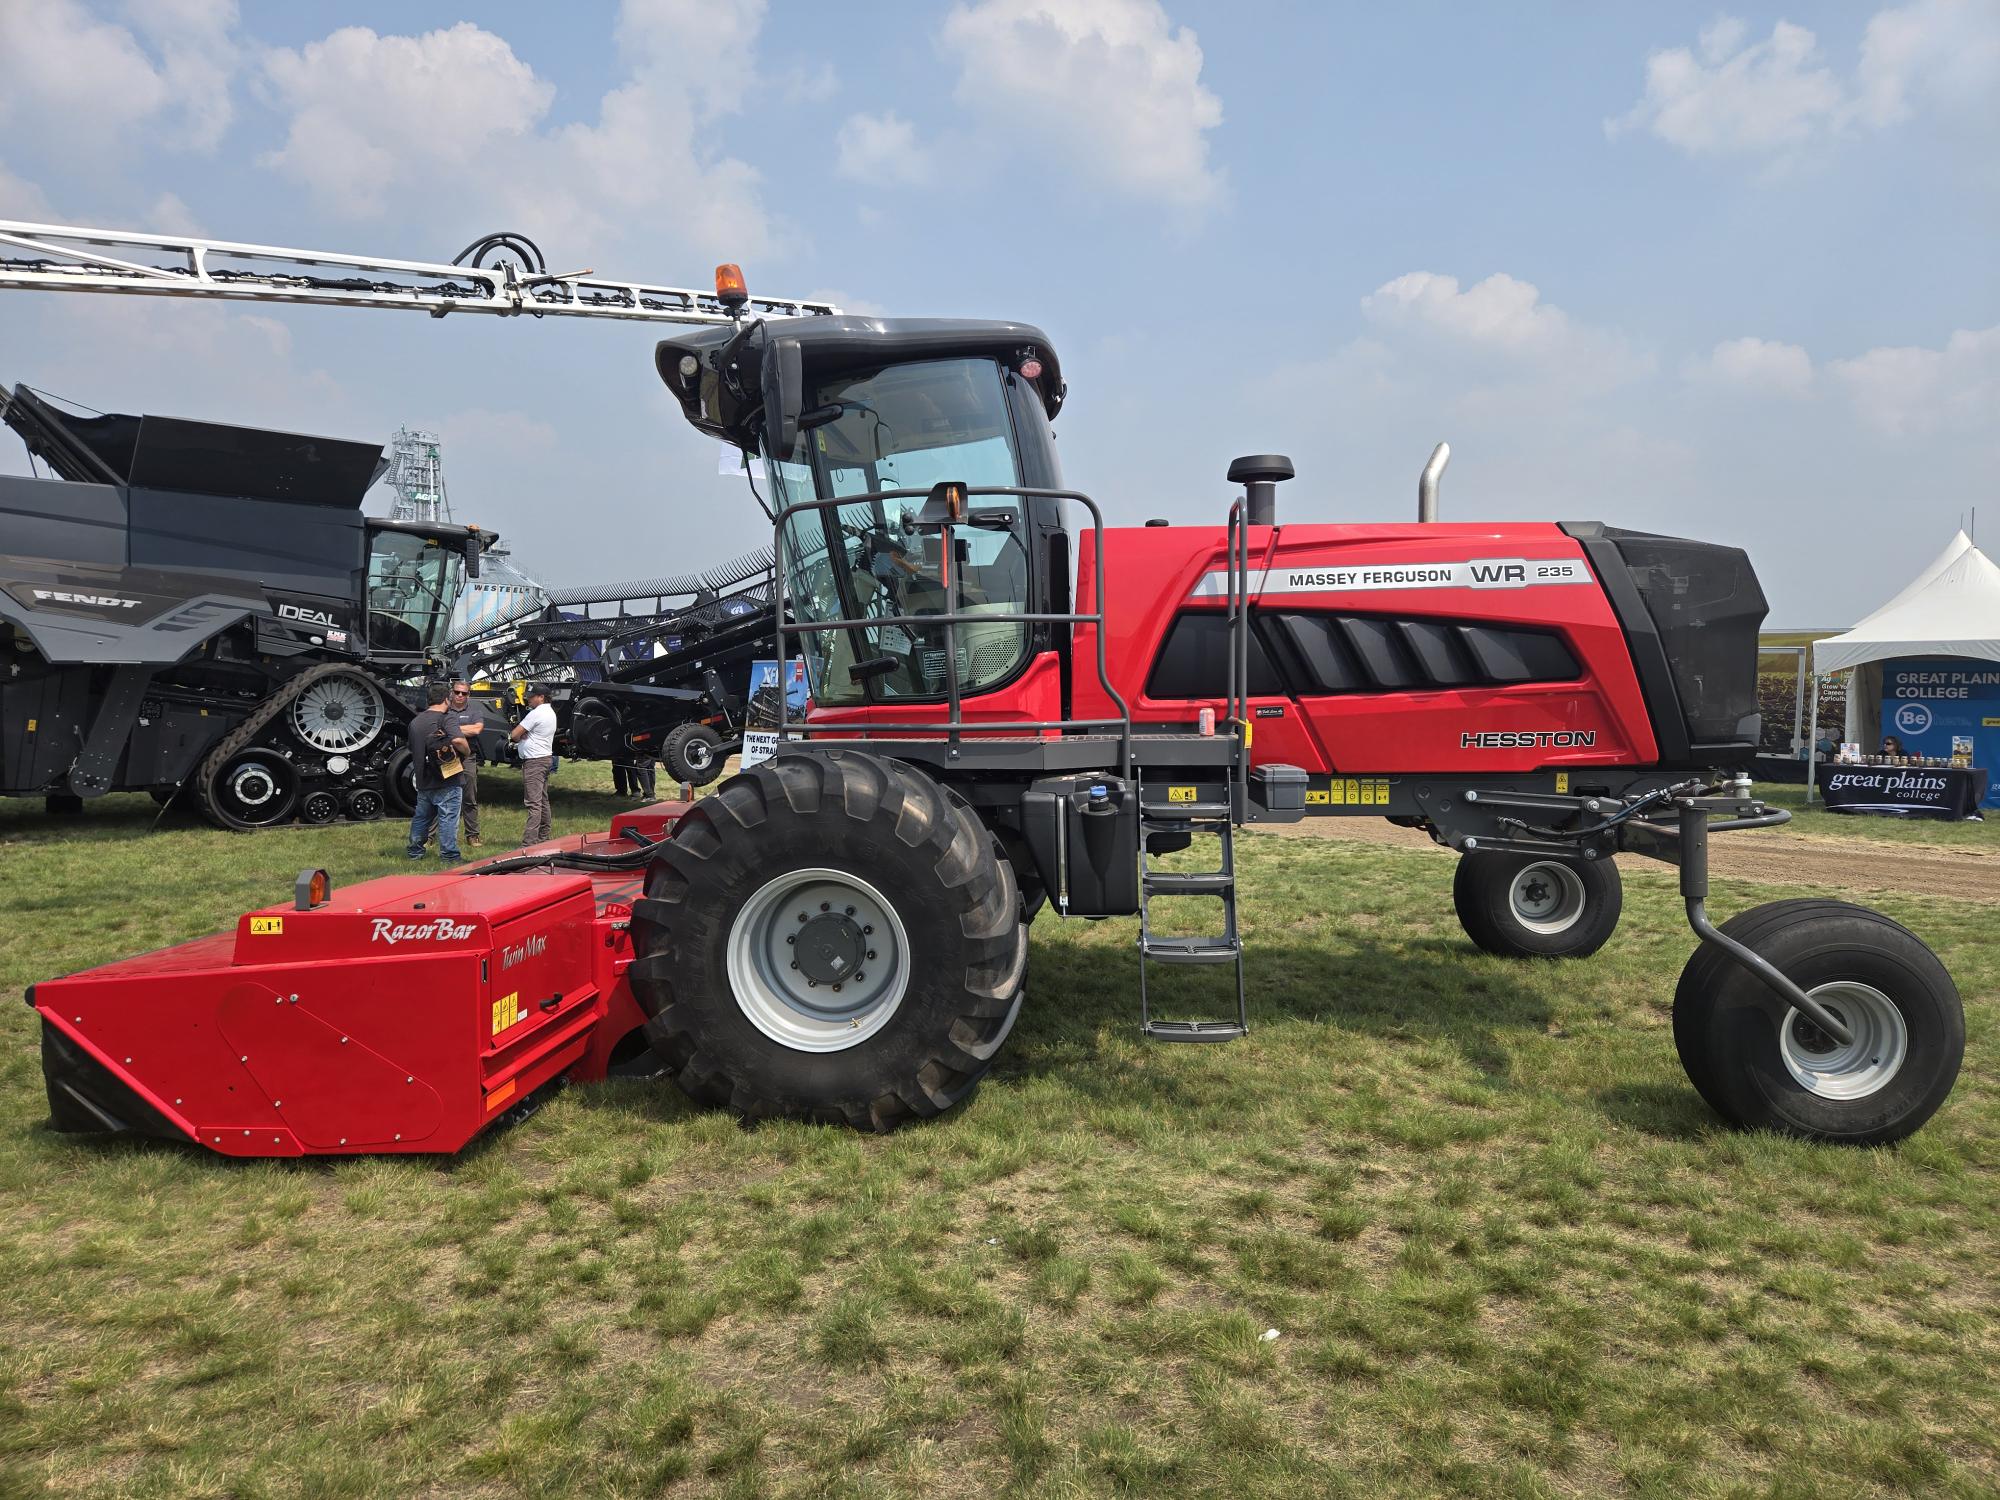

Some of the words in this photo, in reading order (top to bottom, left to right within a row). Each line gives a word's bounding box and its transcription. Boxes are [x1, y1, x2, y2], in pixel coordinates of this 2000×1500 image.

[1289, 572, 1356, 587] MASSEY
[1363, 569, 1452, 584] FERGUSON
[1470, 564, 1526, 583] WR
[1537, 566, 1573, 577] 235
[474, 584, 524, 594] WESTEEL
[32, 589, 142, 608] FENDT
[278, 604, 340, 628] IDEAL
[1896, 672, 1948, 684] GREAT
[1951, 672, 2000, 684] PLAIN
[1895, 687, 1969, 699] COLLEGE
[1901, 711, 1927, 725] Be
[746, 735, 756, 743] THE
[756, 736, 770, 744] NEXT
[1460, 731, 1596, 748] HESSTON
[751, 746, 759, 754] OF
[1829, 773, 1884, 791] great
[1883, 771, 1947, 794] plains
[1896, 790, 1941, 801] college
[371, 918, 478, 945] RazorBar
[503, 945, 524, 971] Twin
[524, 934, 547, 961] Max
